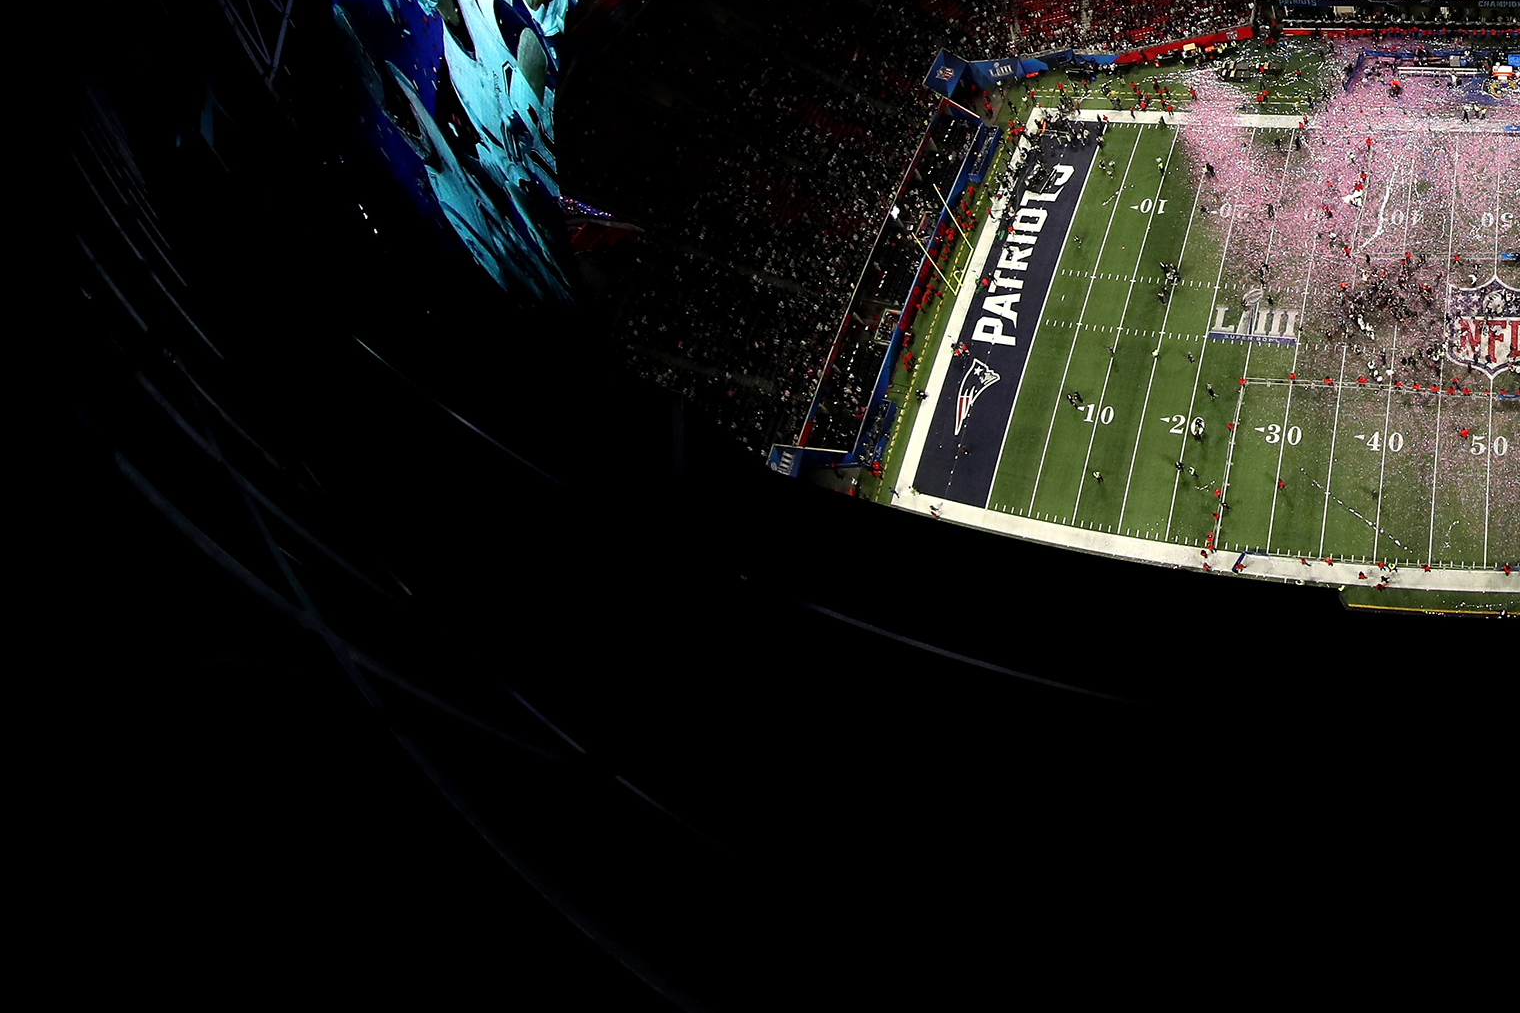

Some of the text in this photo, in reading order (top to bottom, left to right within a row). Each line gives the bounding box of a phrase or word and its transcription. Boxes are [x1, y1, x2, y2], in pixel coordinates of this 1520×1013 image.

[1139, 198, 1168, 215] 10
[1211, 306, 1298, 337] LIII
[1224, 333, 1253, 341] SUPER
[1083, 404, 1115, 425] 10
[1169, 414, 1205, 436] 20
[1264, 424, 1302, 446] 30
[1366, 430, 1404, 453] 40
[1470, 435, 1508, 457] 50
